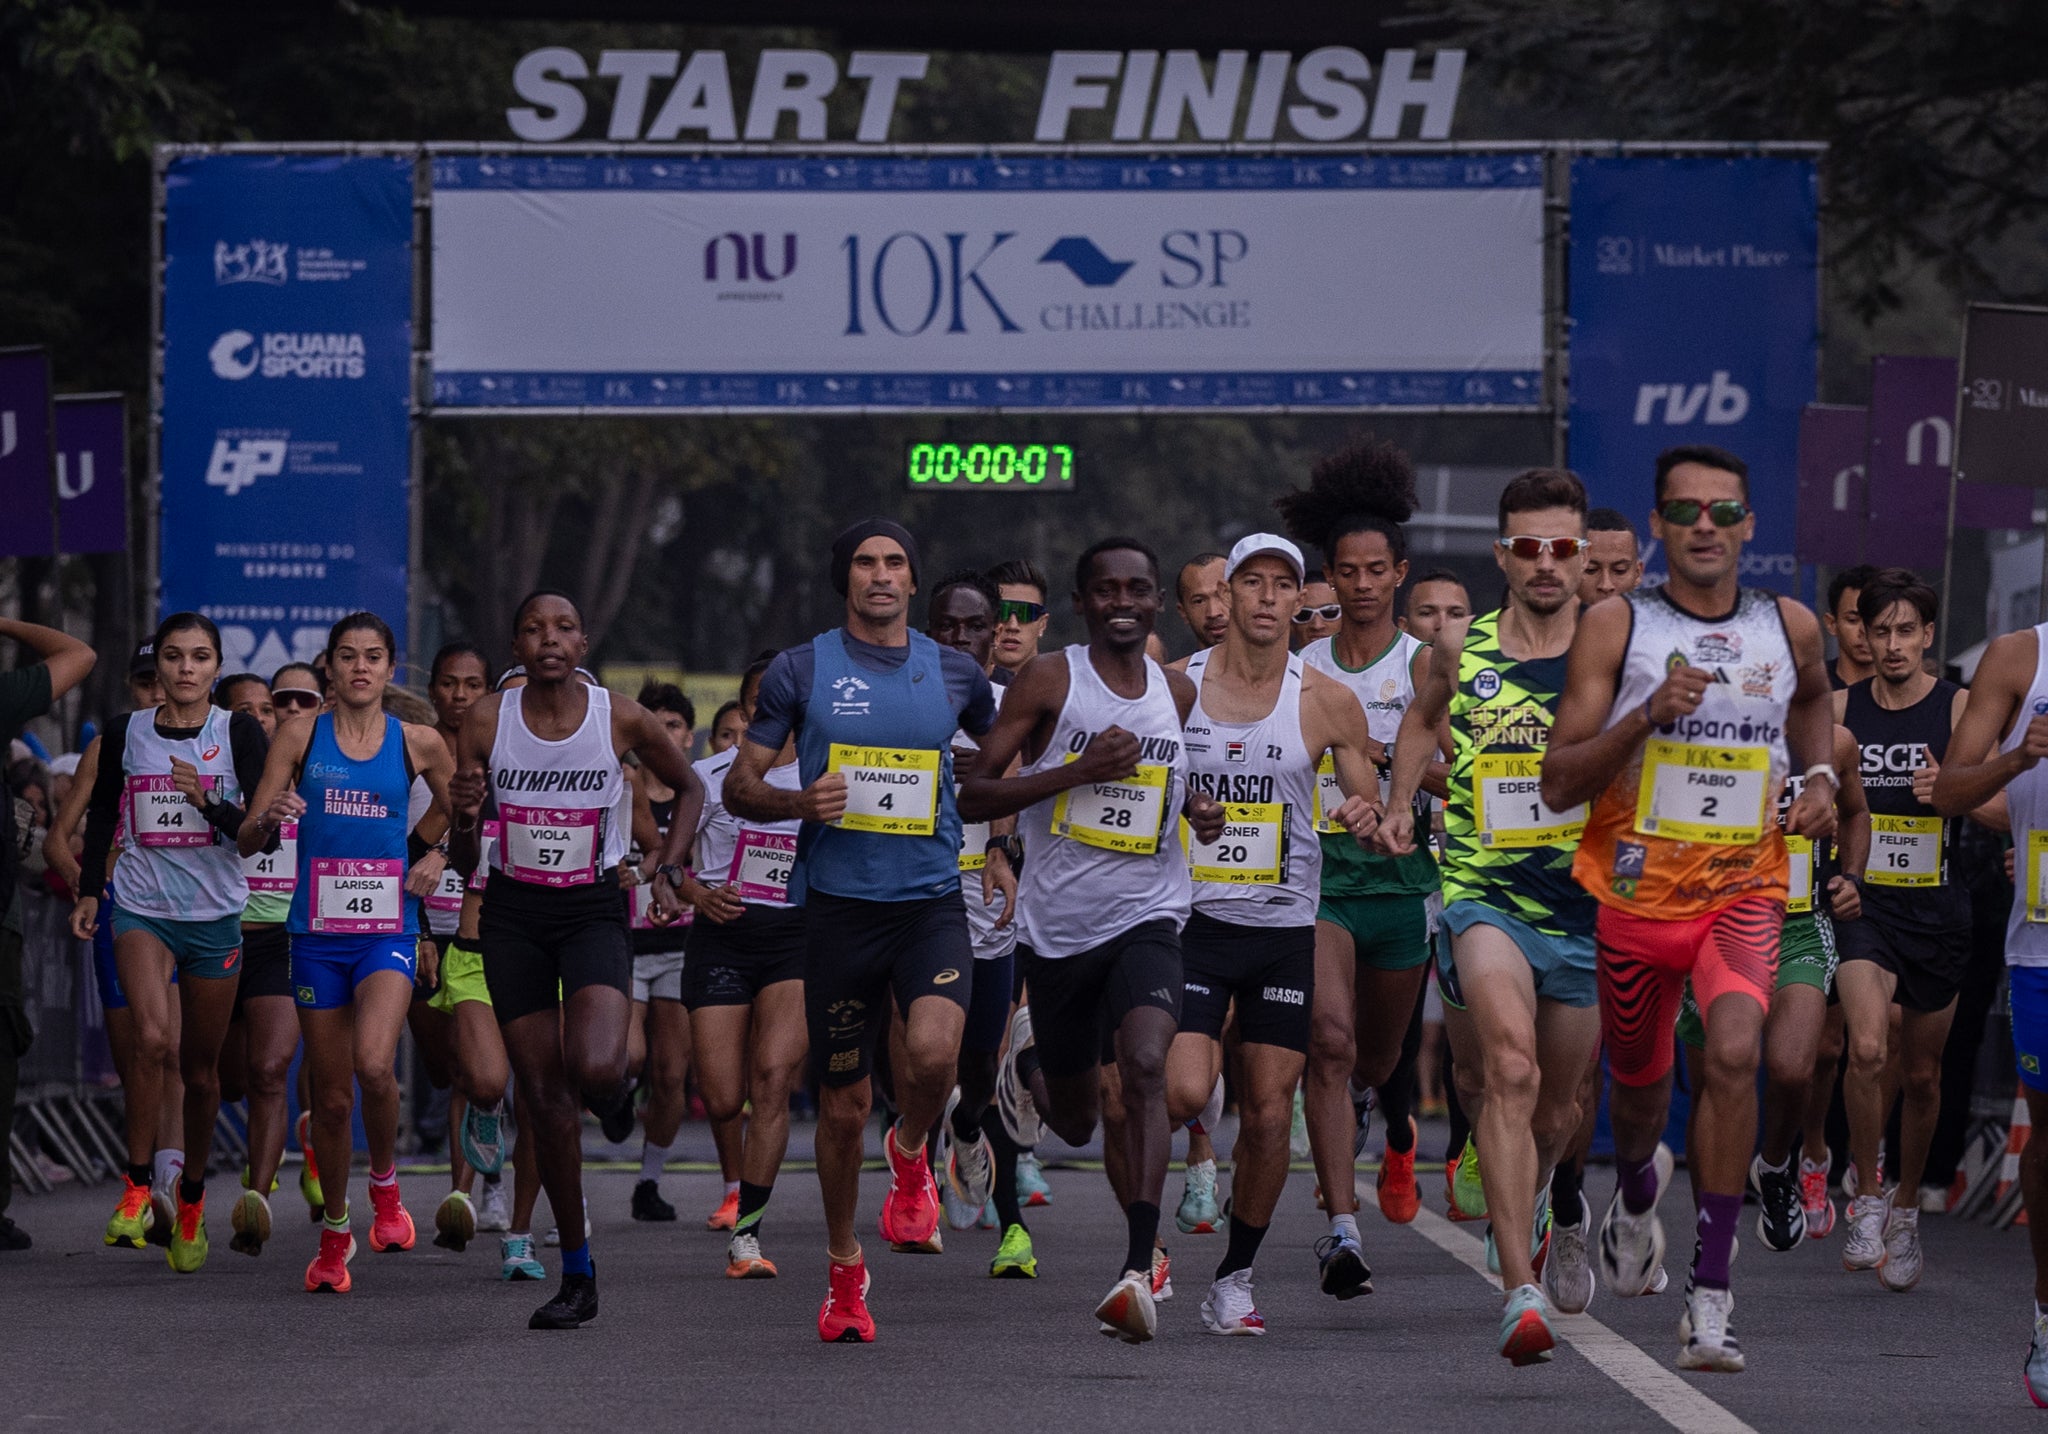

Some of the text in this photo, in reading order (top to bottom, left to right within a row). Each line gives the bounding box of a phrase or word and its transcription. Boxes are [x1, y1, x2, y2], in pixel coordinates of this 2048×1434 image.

[506, 47, 1465, 141] START FINISH
[841, 230, 1248, 337] 10K SP
[1040, 301, 1251, 332] CHALLENGE
[261, 332, 366, 356] IGUANA
[261, 355, 366, 379] SPORTS
[1633, 369, 1750, 425] rvb
[909, 442, 1073, 484] 00:00:07
[327, 544, 356, 560] DO
[242, 563, 326, 579] ESPORTE
[201, 604, 360, 622] GOVERNO FEDER
[1470, 706, 1536, 726] ELITE
[1185, 726, 1211, 736] MPD
[1472, 726, 1549, 747] RUNNE
[1070, 731, 1179, 763] OIKUS
[863, 750, 890, 768] 10K
[854, 770, 920, 785] IVANILDO
[1504, 760, 1533, 777] 10K
[496, 769, 608, 792] OLYMPIKUS
[1189, 771, 1274, 804] OSASCO
[1498, 781, 1541, 794] EDERS
[1687, 772, 1737, 788] FABIO
[324, 788, 371, 803] ELITE
[1093, 784, 1146, 801] VESTUS
[323, 800, 389, 819] RUNNERS
[878, 793, 894, 811] 4
[1700, 797, 1719, 817] 2
[156, 812, 184, 827] 44
[526, 809, 553, 826] 10K
[1099, 807, 1131, 828] 28
[1530, 803, 1541, 821] 1
[529, 829, 571, 842] VIOLA
[1220, 826, 1260, 838] GNER
[1879, 834, 1919, 848] FELIPE
[538, 848, 565, 867] 57
[748, 848, 794, 864] VANDER
[1216, 845, 1248, 863] 20
[1887, 851, 1910, 869] 16
[256, 858, 274, 873] 41
[337, 862, 361, 876] 10K
[334, 880, 384, 890] LARISSA
[346, 897, 373, 913] 48
